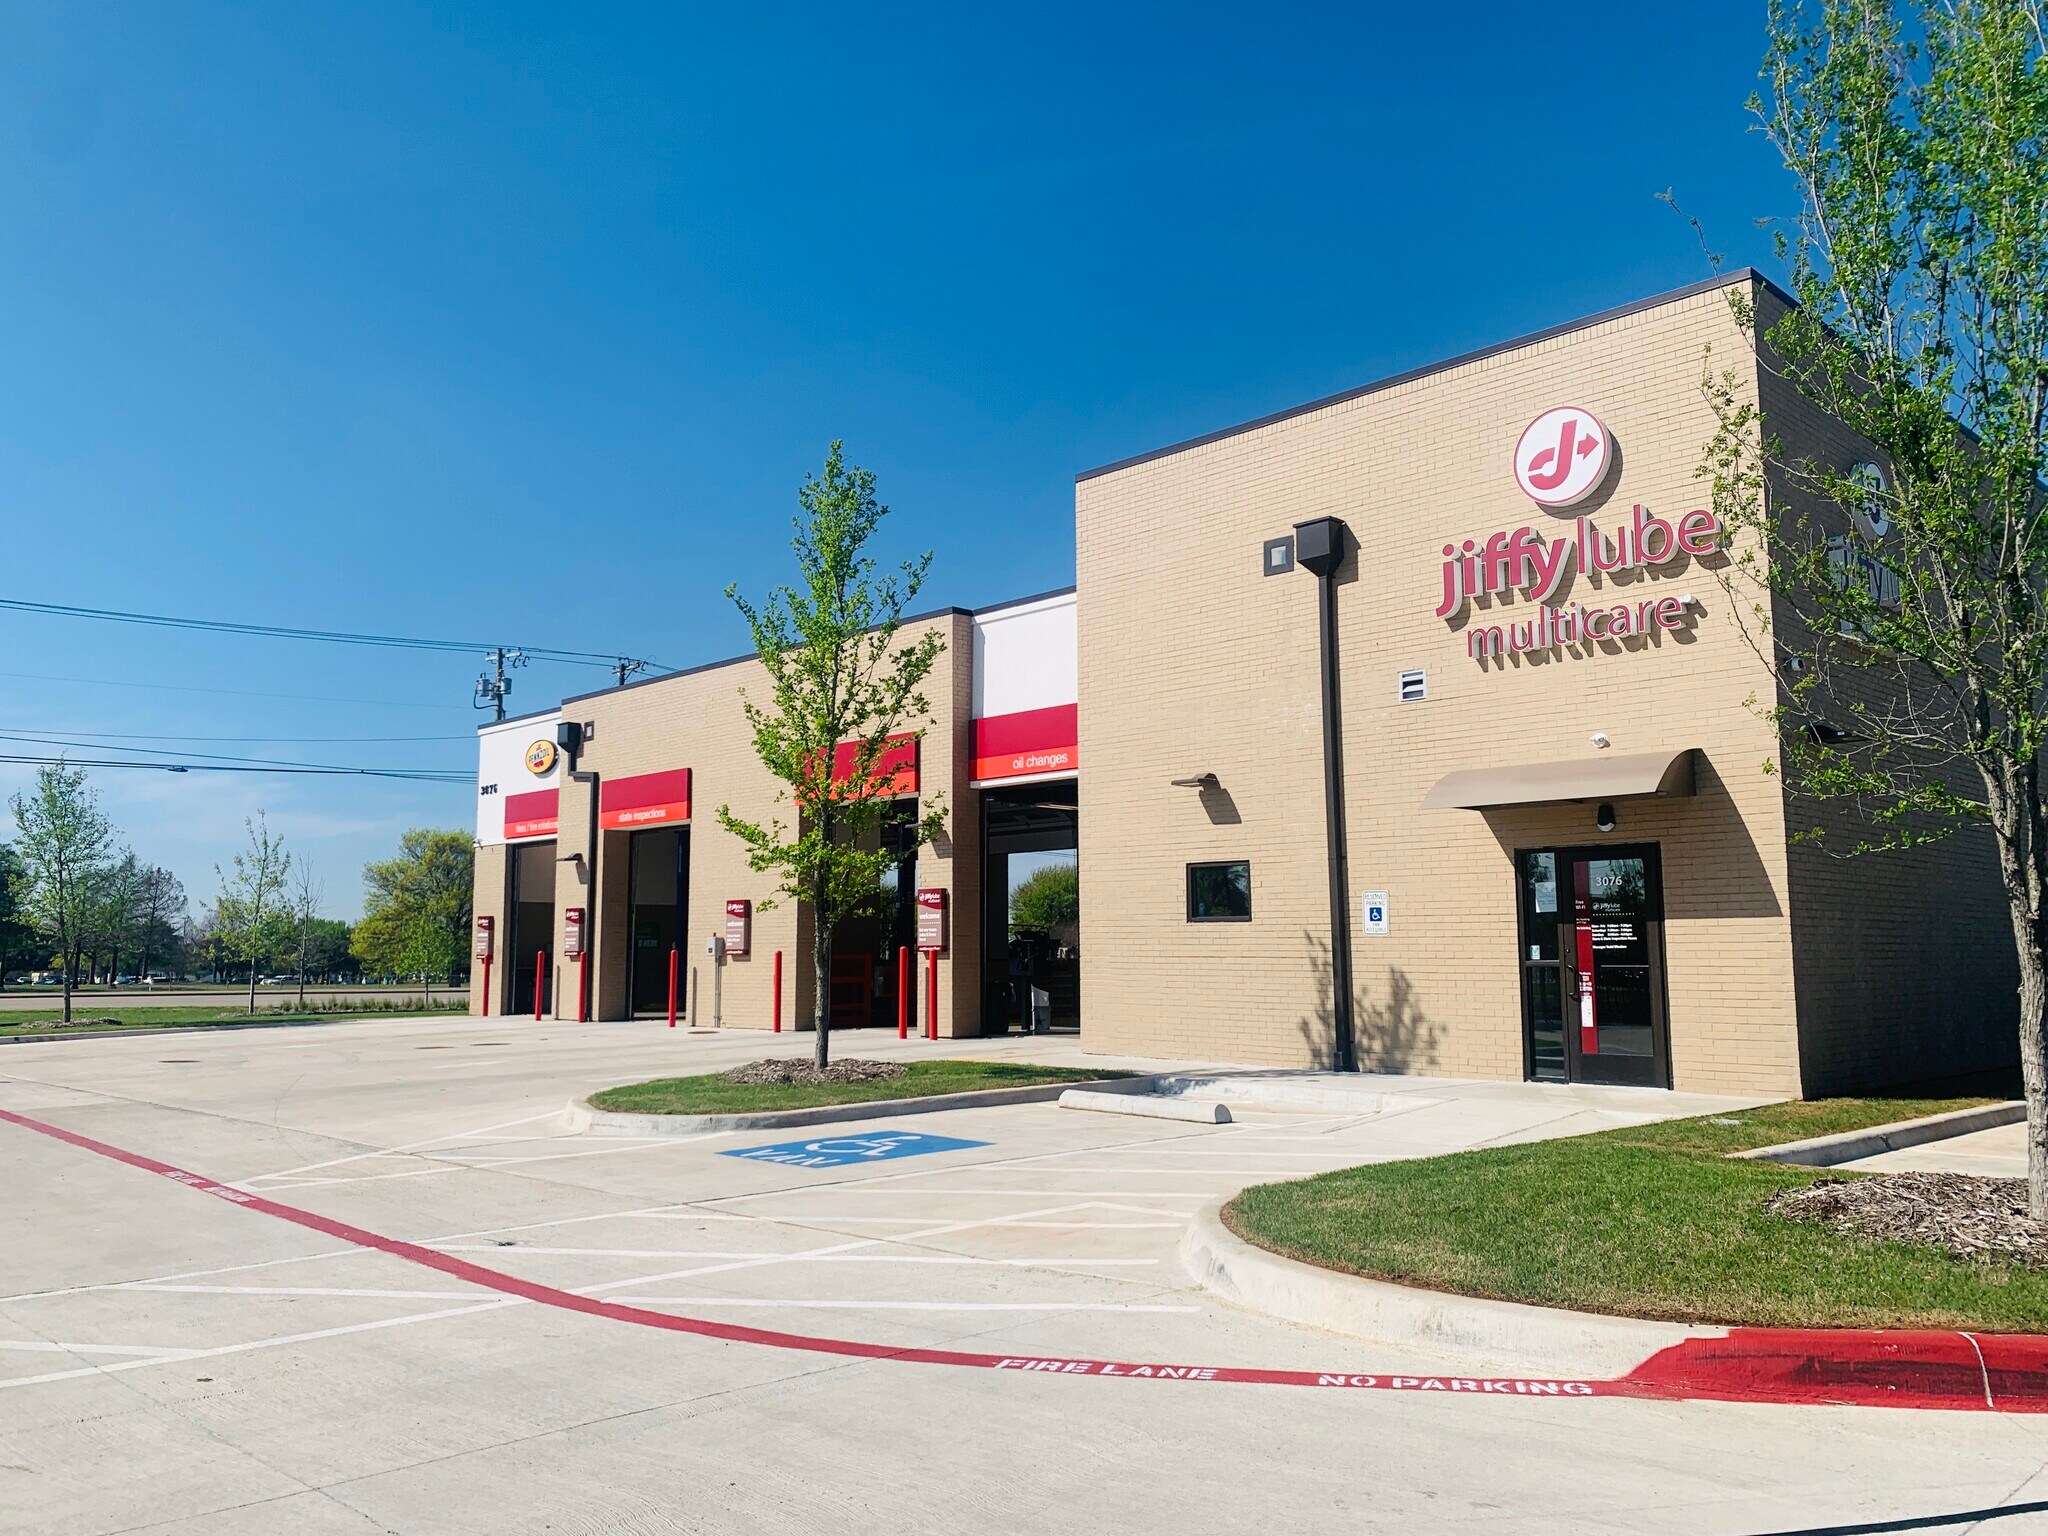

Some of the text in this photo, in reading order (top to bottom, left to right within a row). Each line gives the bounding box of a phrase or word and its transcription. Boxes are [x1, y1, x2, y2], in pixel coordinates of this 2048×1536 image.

[1467, 595, 1683, 659] multicare
[1012, 753, 1069, 769] oil changes
[618, 808, 667, 822] state inspections
[1595, 876, 1623, 887] 3076
[919, 912, 941, 920] welcome
[740, 1148, 842, 1167] VAN
[991, 1358, 1595, 1396] FIRE LANE NO PARKING
